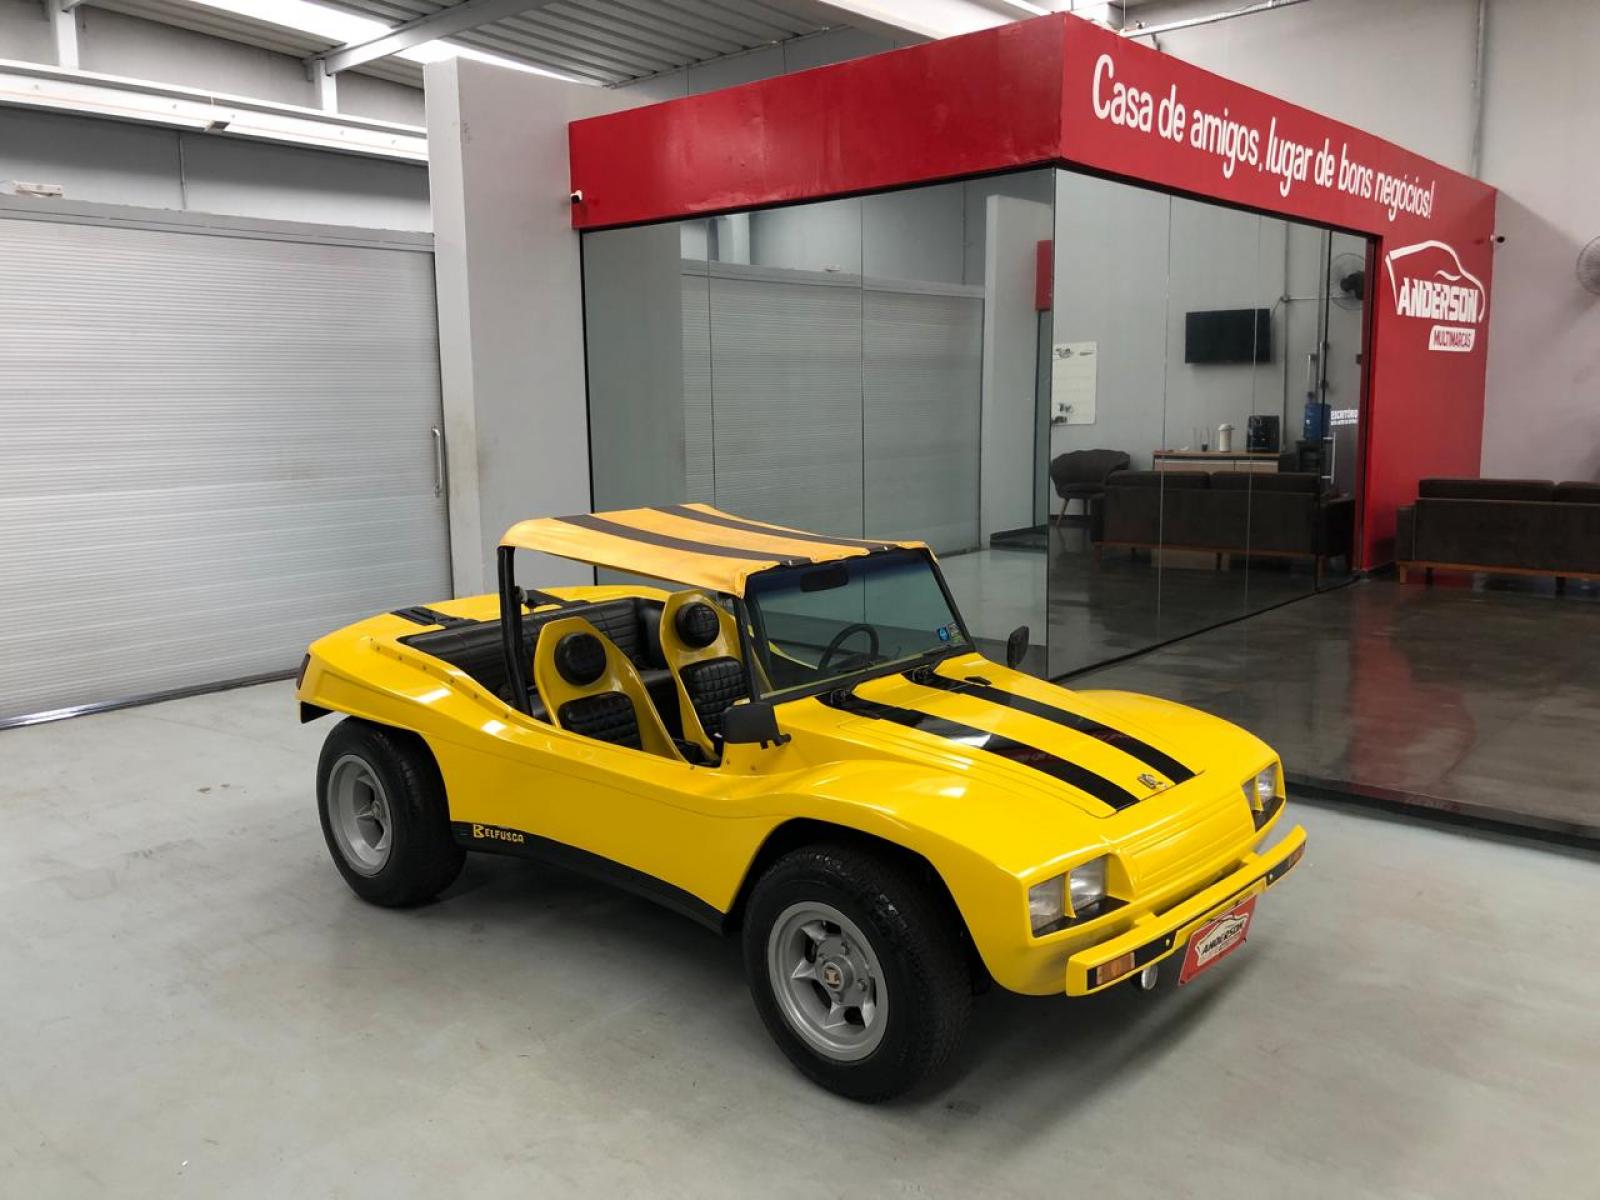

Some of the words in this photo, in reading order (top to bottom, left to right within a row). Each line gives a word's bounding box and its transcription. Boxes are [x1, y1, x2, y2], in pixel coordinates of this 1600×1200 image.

[1092, 53, 1154, 134] Casa
[1158, 83, 1186, 143] de
[1190, 107, 1263, 179] amigos,
[1265, 116, 1313, 198] lugar
[1314, 137, 1335, 189] de
[1337, 142, 1373, 200] bons
[1374, 171, 1436, 222] negócios!
[1397, 277, 1479, 324] ANDERSON
[1433, 329, 1472, 348] MULTIMARCAS
[473, 823, 525, 845] BELFUSCA
[1200, 921, 1244, 956] ANDERSON
